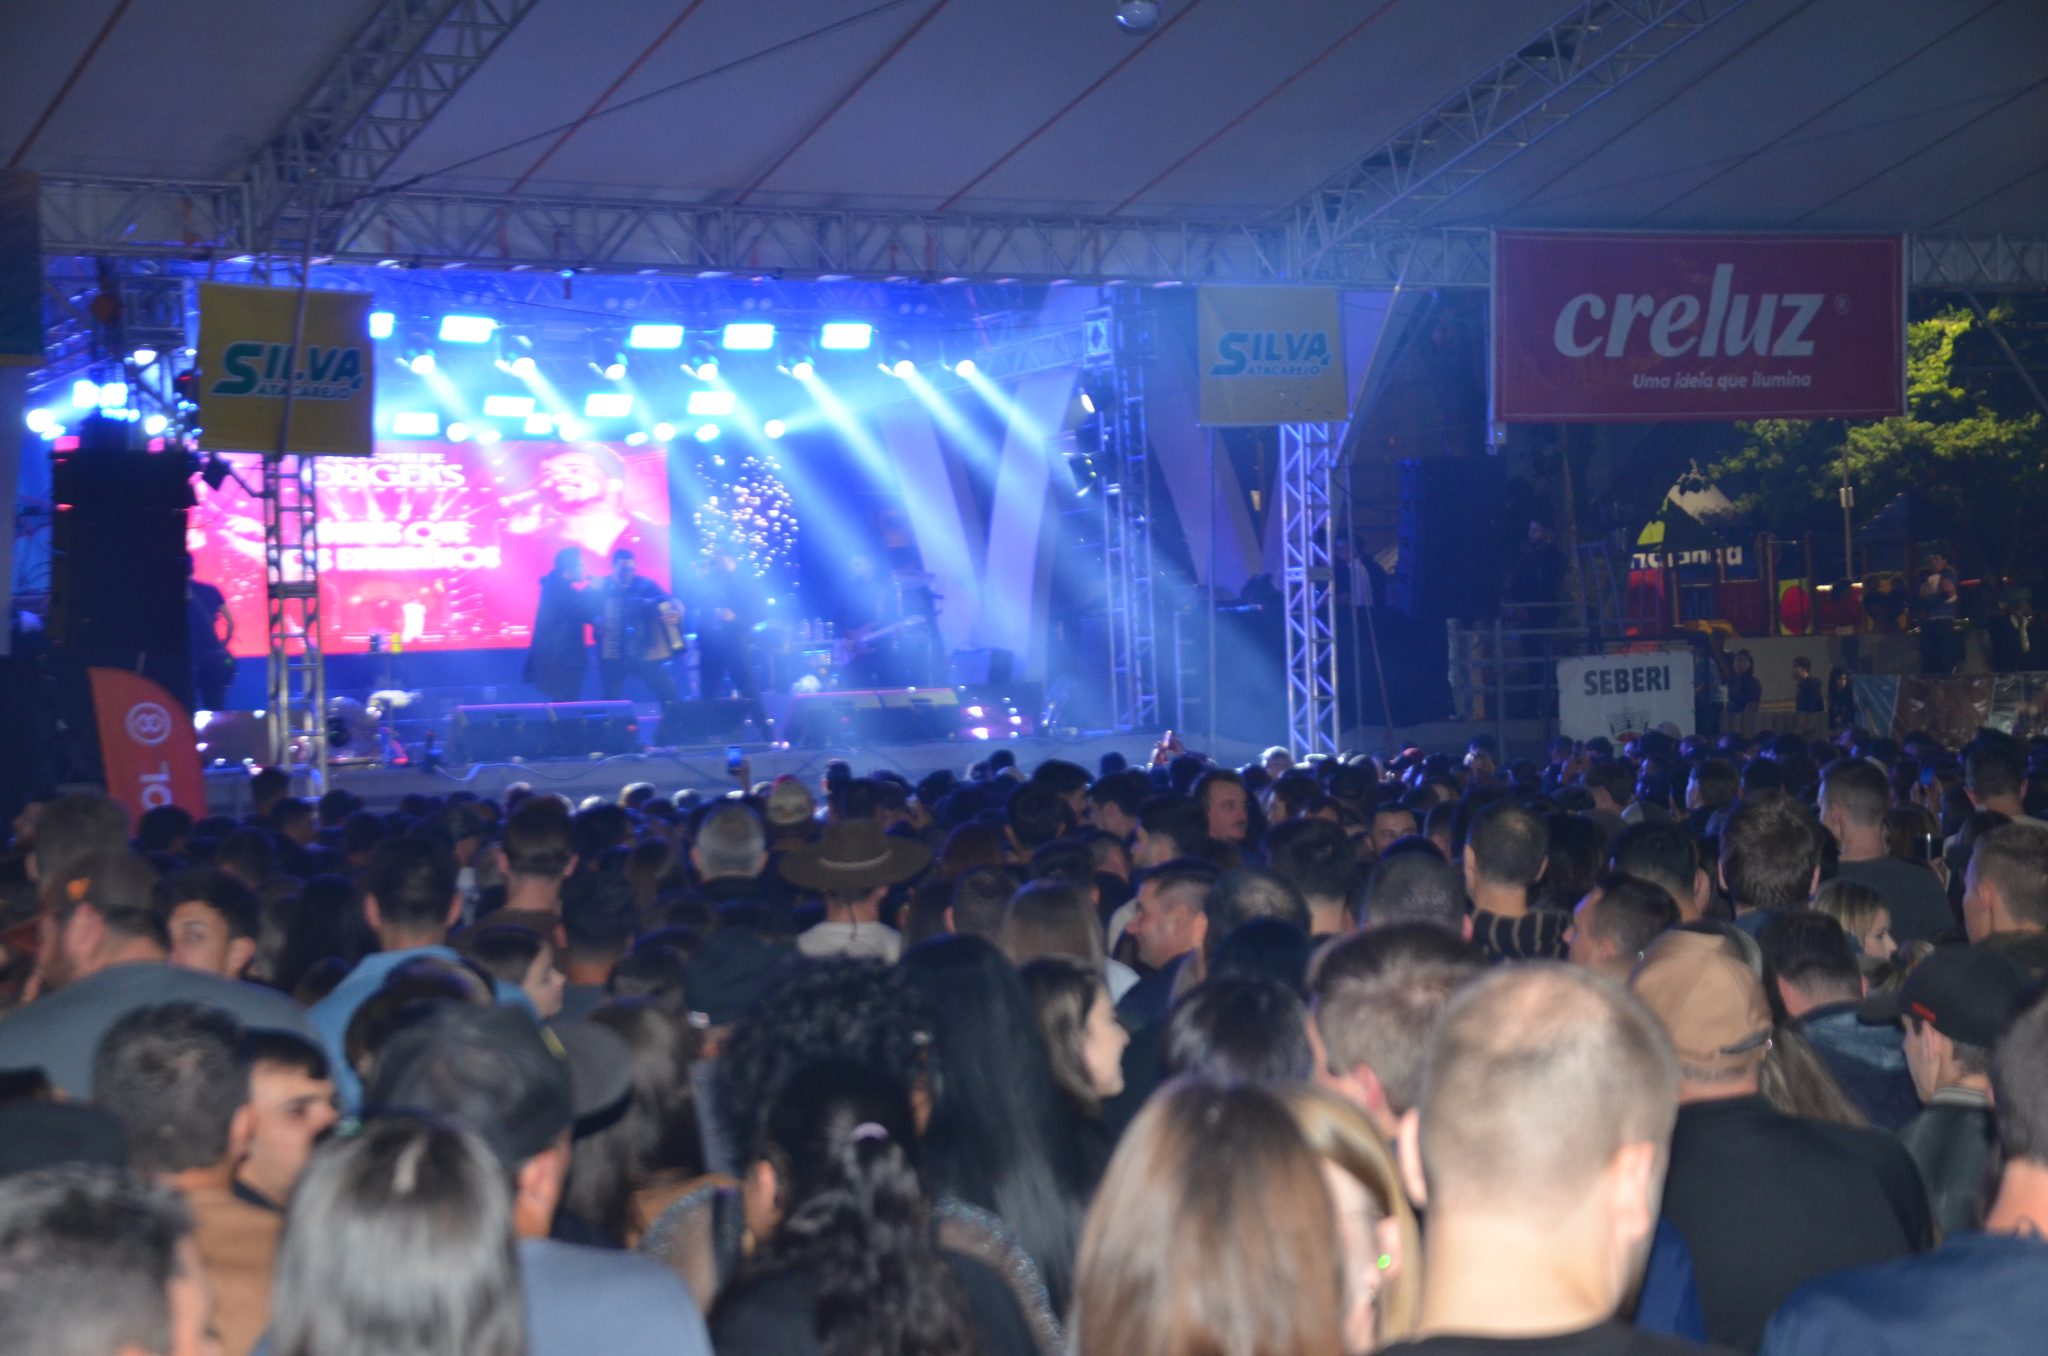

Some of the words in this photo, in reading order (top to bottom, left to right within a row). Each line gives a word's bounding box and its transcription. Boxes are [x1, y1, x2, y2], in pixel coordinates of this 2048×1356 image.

[1554, 263, 1825, 357] creluz
[211, 341, 365, 394] SILVA
[1209, 331, 1331, 376] SILVA
[1633, 374, 1670, 389] Uma
[1717, 375, 1749, 391] que
[1752, 371, 1811, 388] ilumina
[1584, 665, 1671, 696] SEBERI
